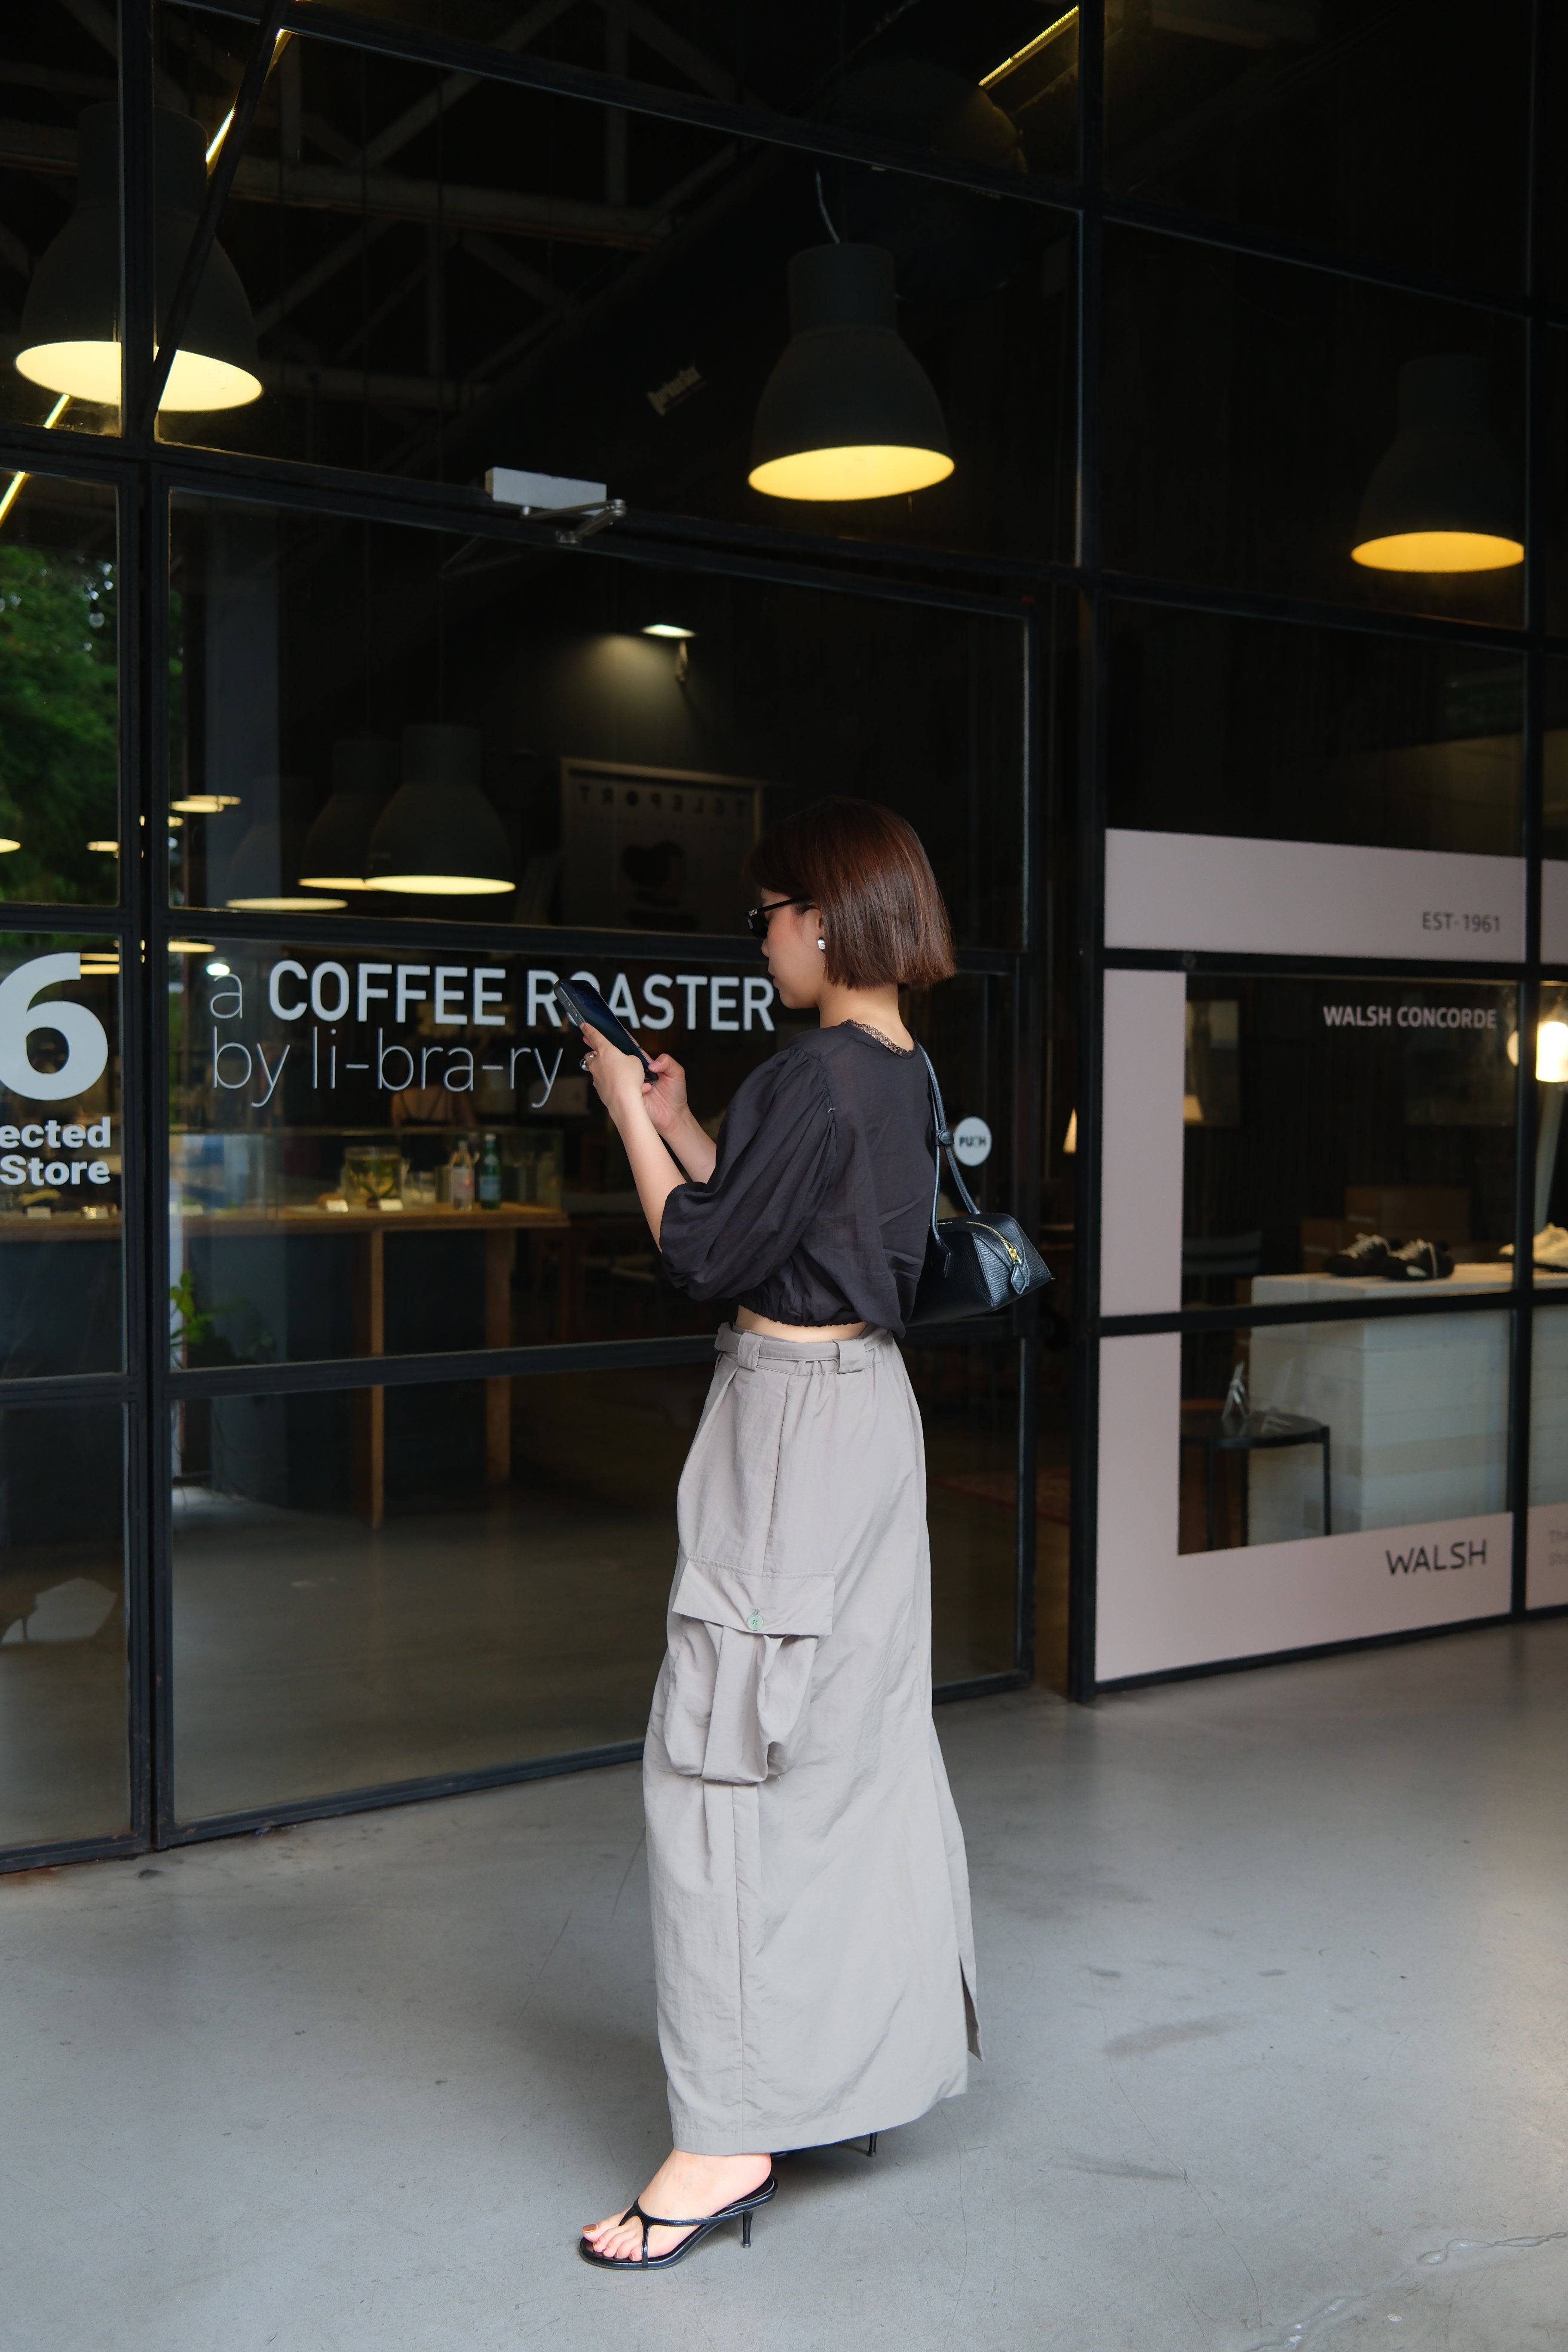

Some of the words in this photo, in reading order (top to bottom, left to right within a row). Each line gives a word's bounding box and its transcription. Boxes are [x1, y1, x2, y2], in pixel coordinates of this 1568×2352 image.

[1463, 913, 1500, 934] 1961
[210, 973, 243, 1019] a
[269, 959, 506, 1026] COFFEE
[0, 952, 109, 1101] 6
[1323, 1005, 1392, 1027] WALSH
[1396, 1006, 1498, 1030] CONCORDE
[213, 1026, 291, 1107] by
[313, 1026, 564, 1109] li-bra-ry
[959, 1136, 986, 1148] PUH
[0, 1154, 111, 1186] Store
[1385, 1538, 1487, 1576] WALSH
